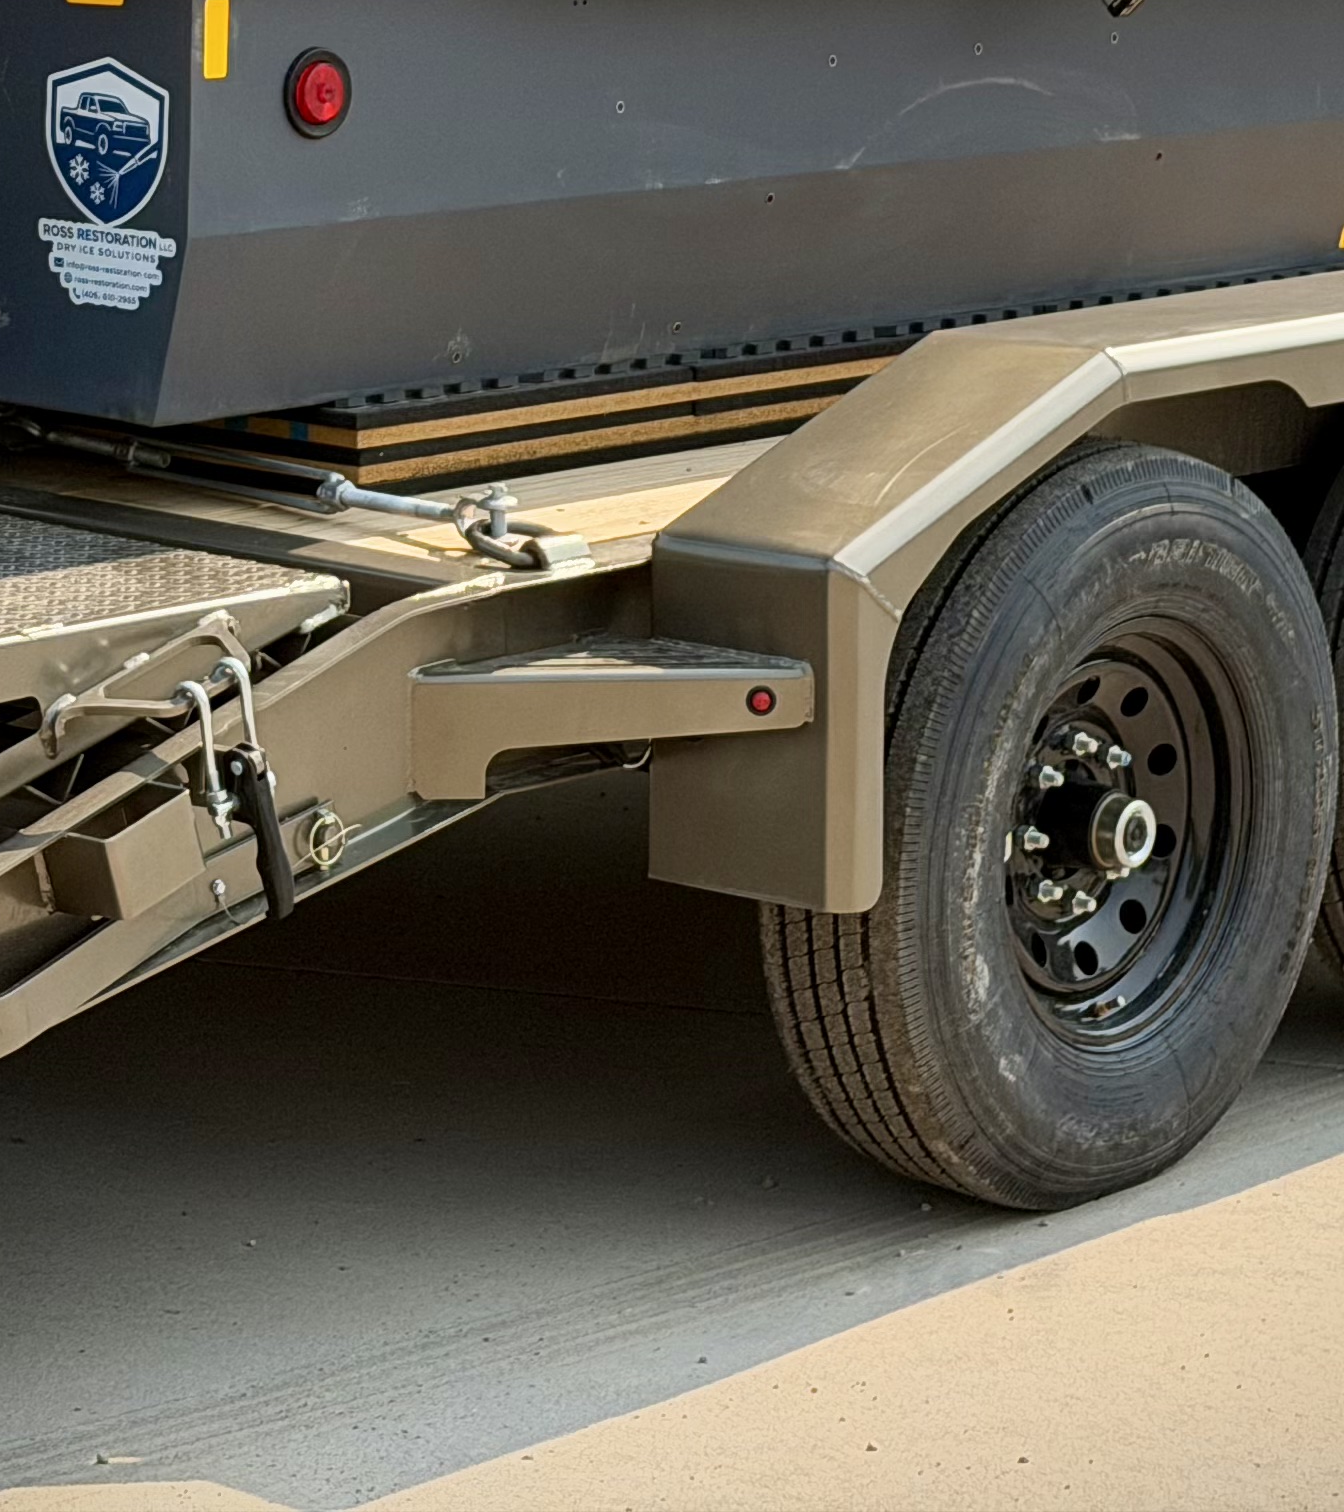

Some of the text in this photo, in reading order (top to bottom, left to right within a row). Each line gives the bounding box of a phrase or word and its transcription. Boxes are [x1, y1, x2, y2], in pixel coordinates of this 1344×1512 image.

[43, 224, 173, 253] ROSS RESTORATION LLC
[56, 242, 156, 264] DRY ICE SOLUTIONS
